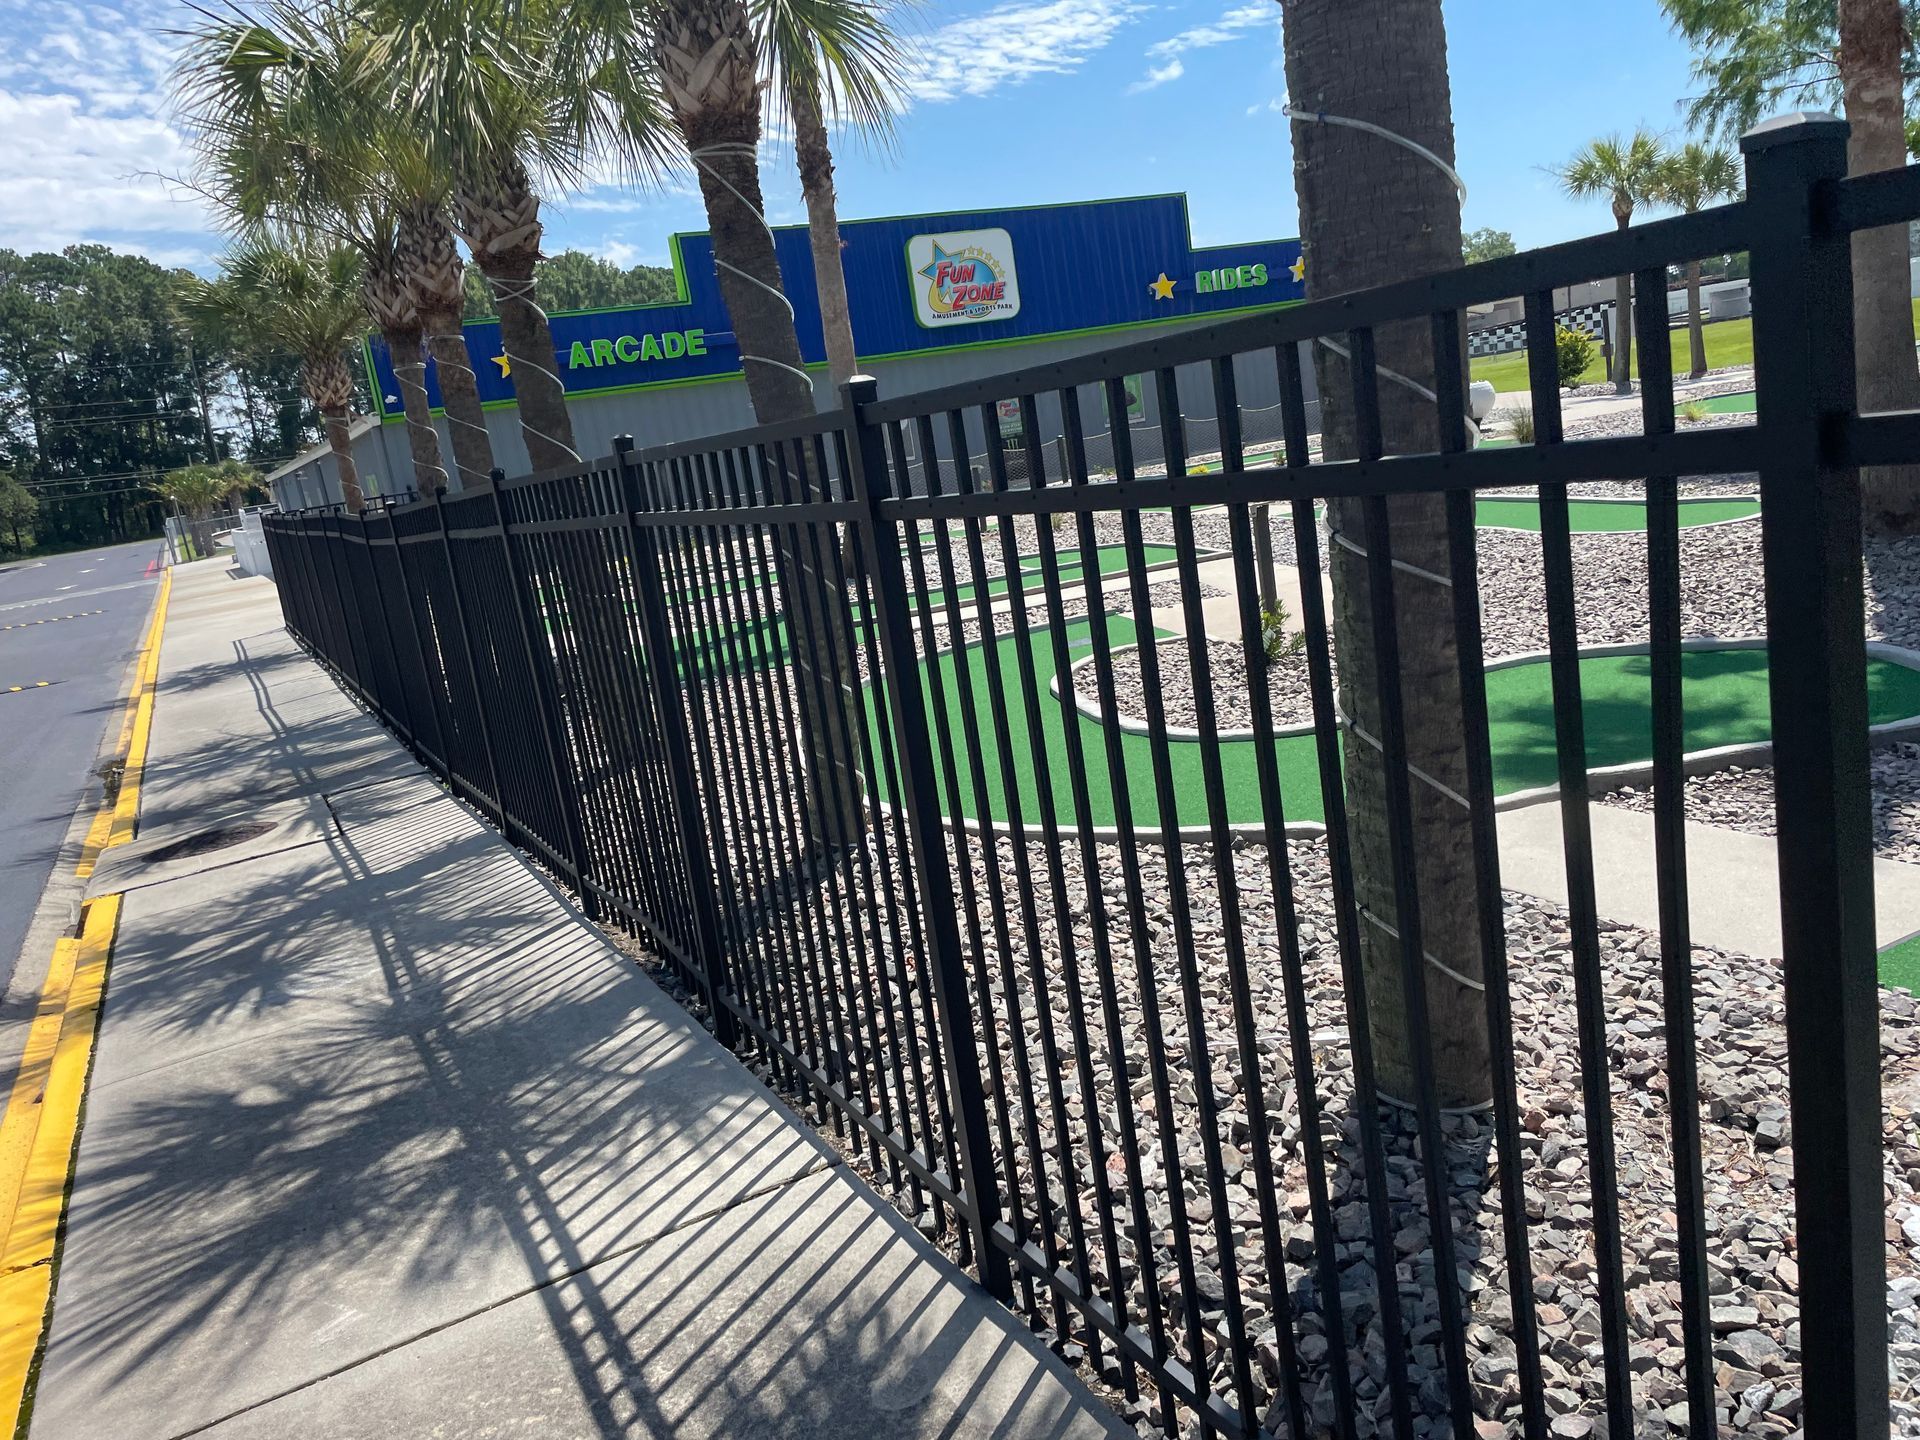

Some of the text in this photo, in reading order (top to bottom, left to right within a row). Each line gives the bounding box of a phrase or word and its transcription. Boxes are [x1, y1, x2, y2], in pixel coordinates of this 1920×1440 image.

[936, 261, 976, 287] FUN
[1195, 263, 1268, 294] RIDES
[952, 281, 1006, 311] ZONE
[932, 310, 968, 319] AMUSEMENT
[975, 304, 996, 313] SPORTS
[569, 328, 707, 370] ARCADE
